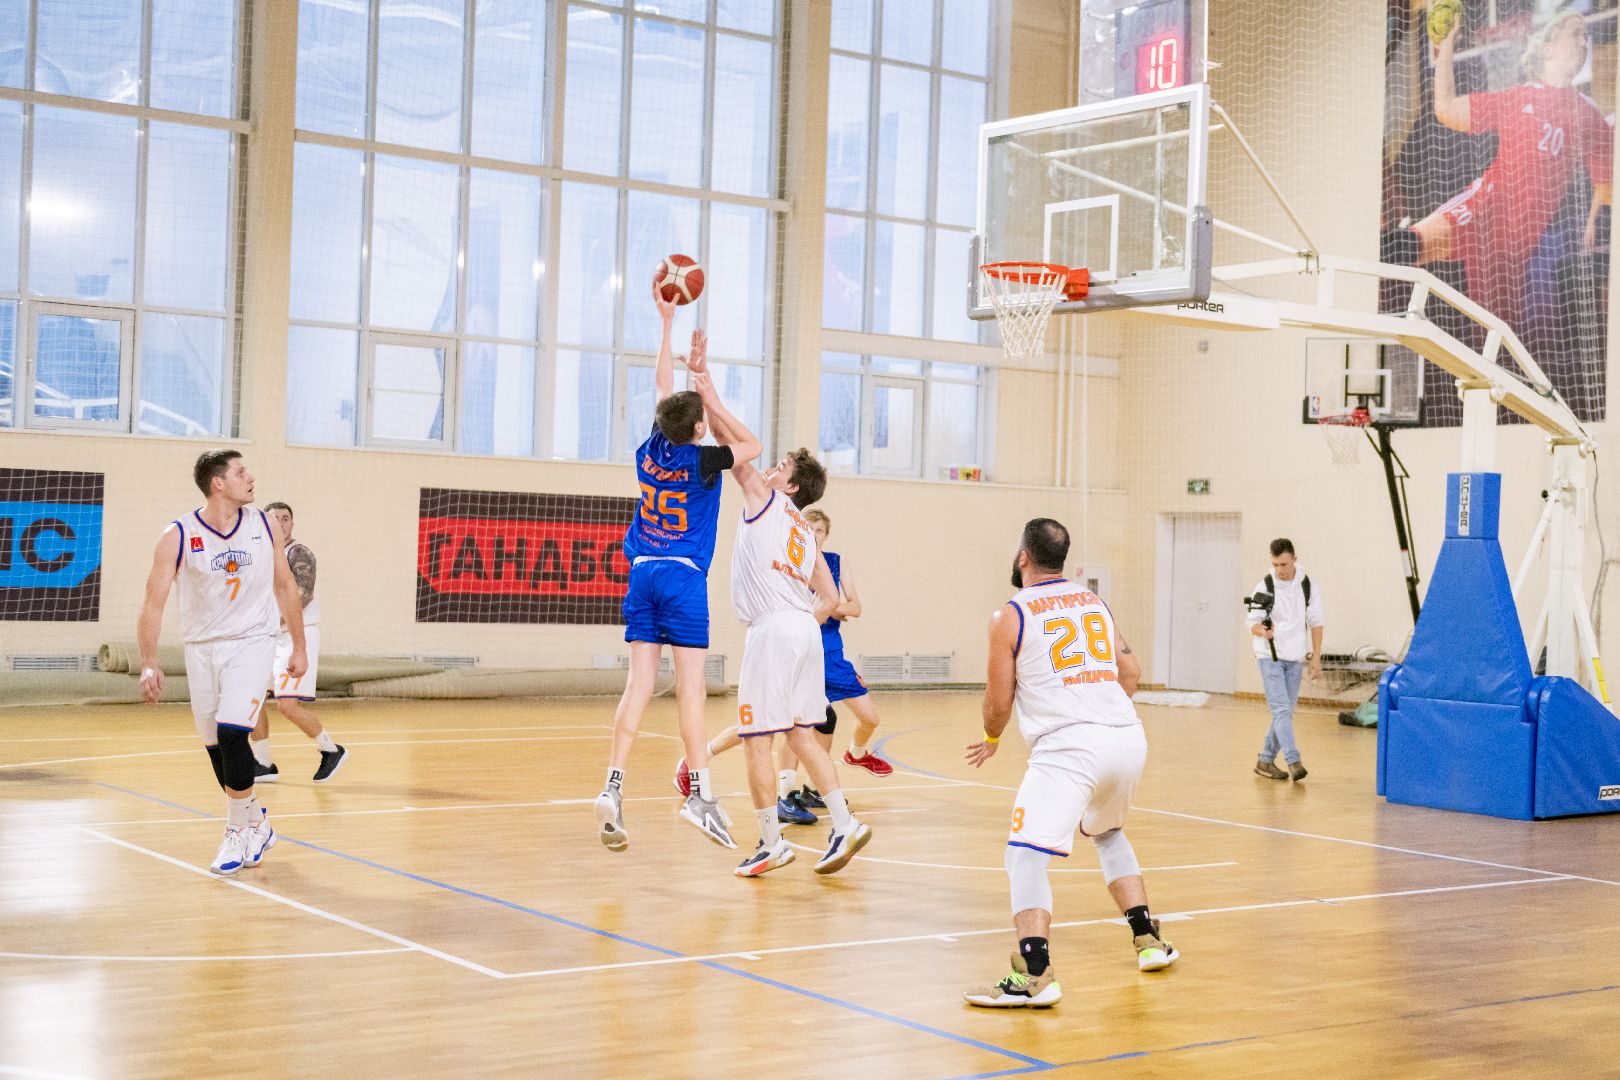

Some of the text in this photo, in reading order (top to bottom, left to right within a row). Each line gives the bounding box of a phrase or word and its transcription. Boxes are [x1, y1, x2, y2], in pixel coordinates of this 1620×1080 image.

[1149, 38, 1177, 89] 10
[1537, 122, 1565, 156] 20
[1451, 204, 1473, 226] 20
[639, 481, 688, 532] 25
[787, 526, 806, 568] 6
[225, 577, 241, 601] 7
[1043, 611, 1113, 674] 28
[247, 697, 260, 721] 7
[739, 704, 753, 726] 6
